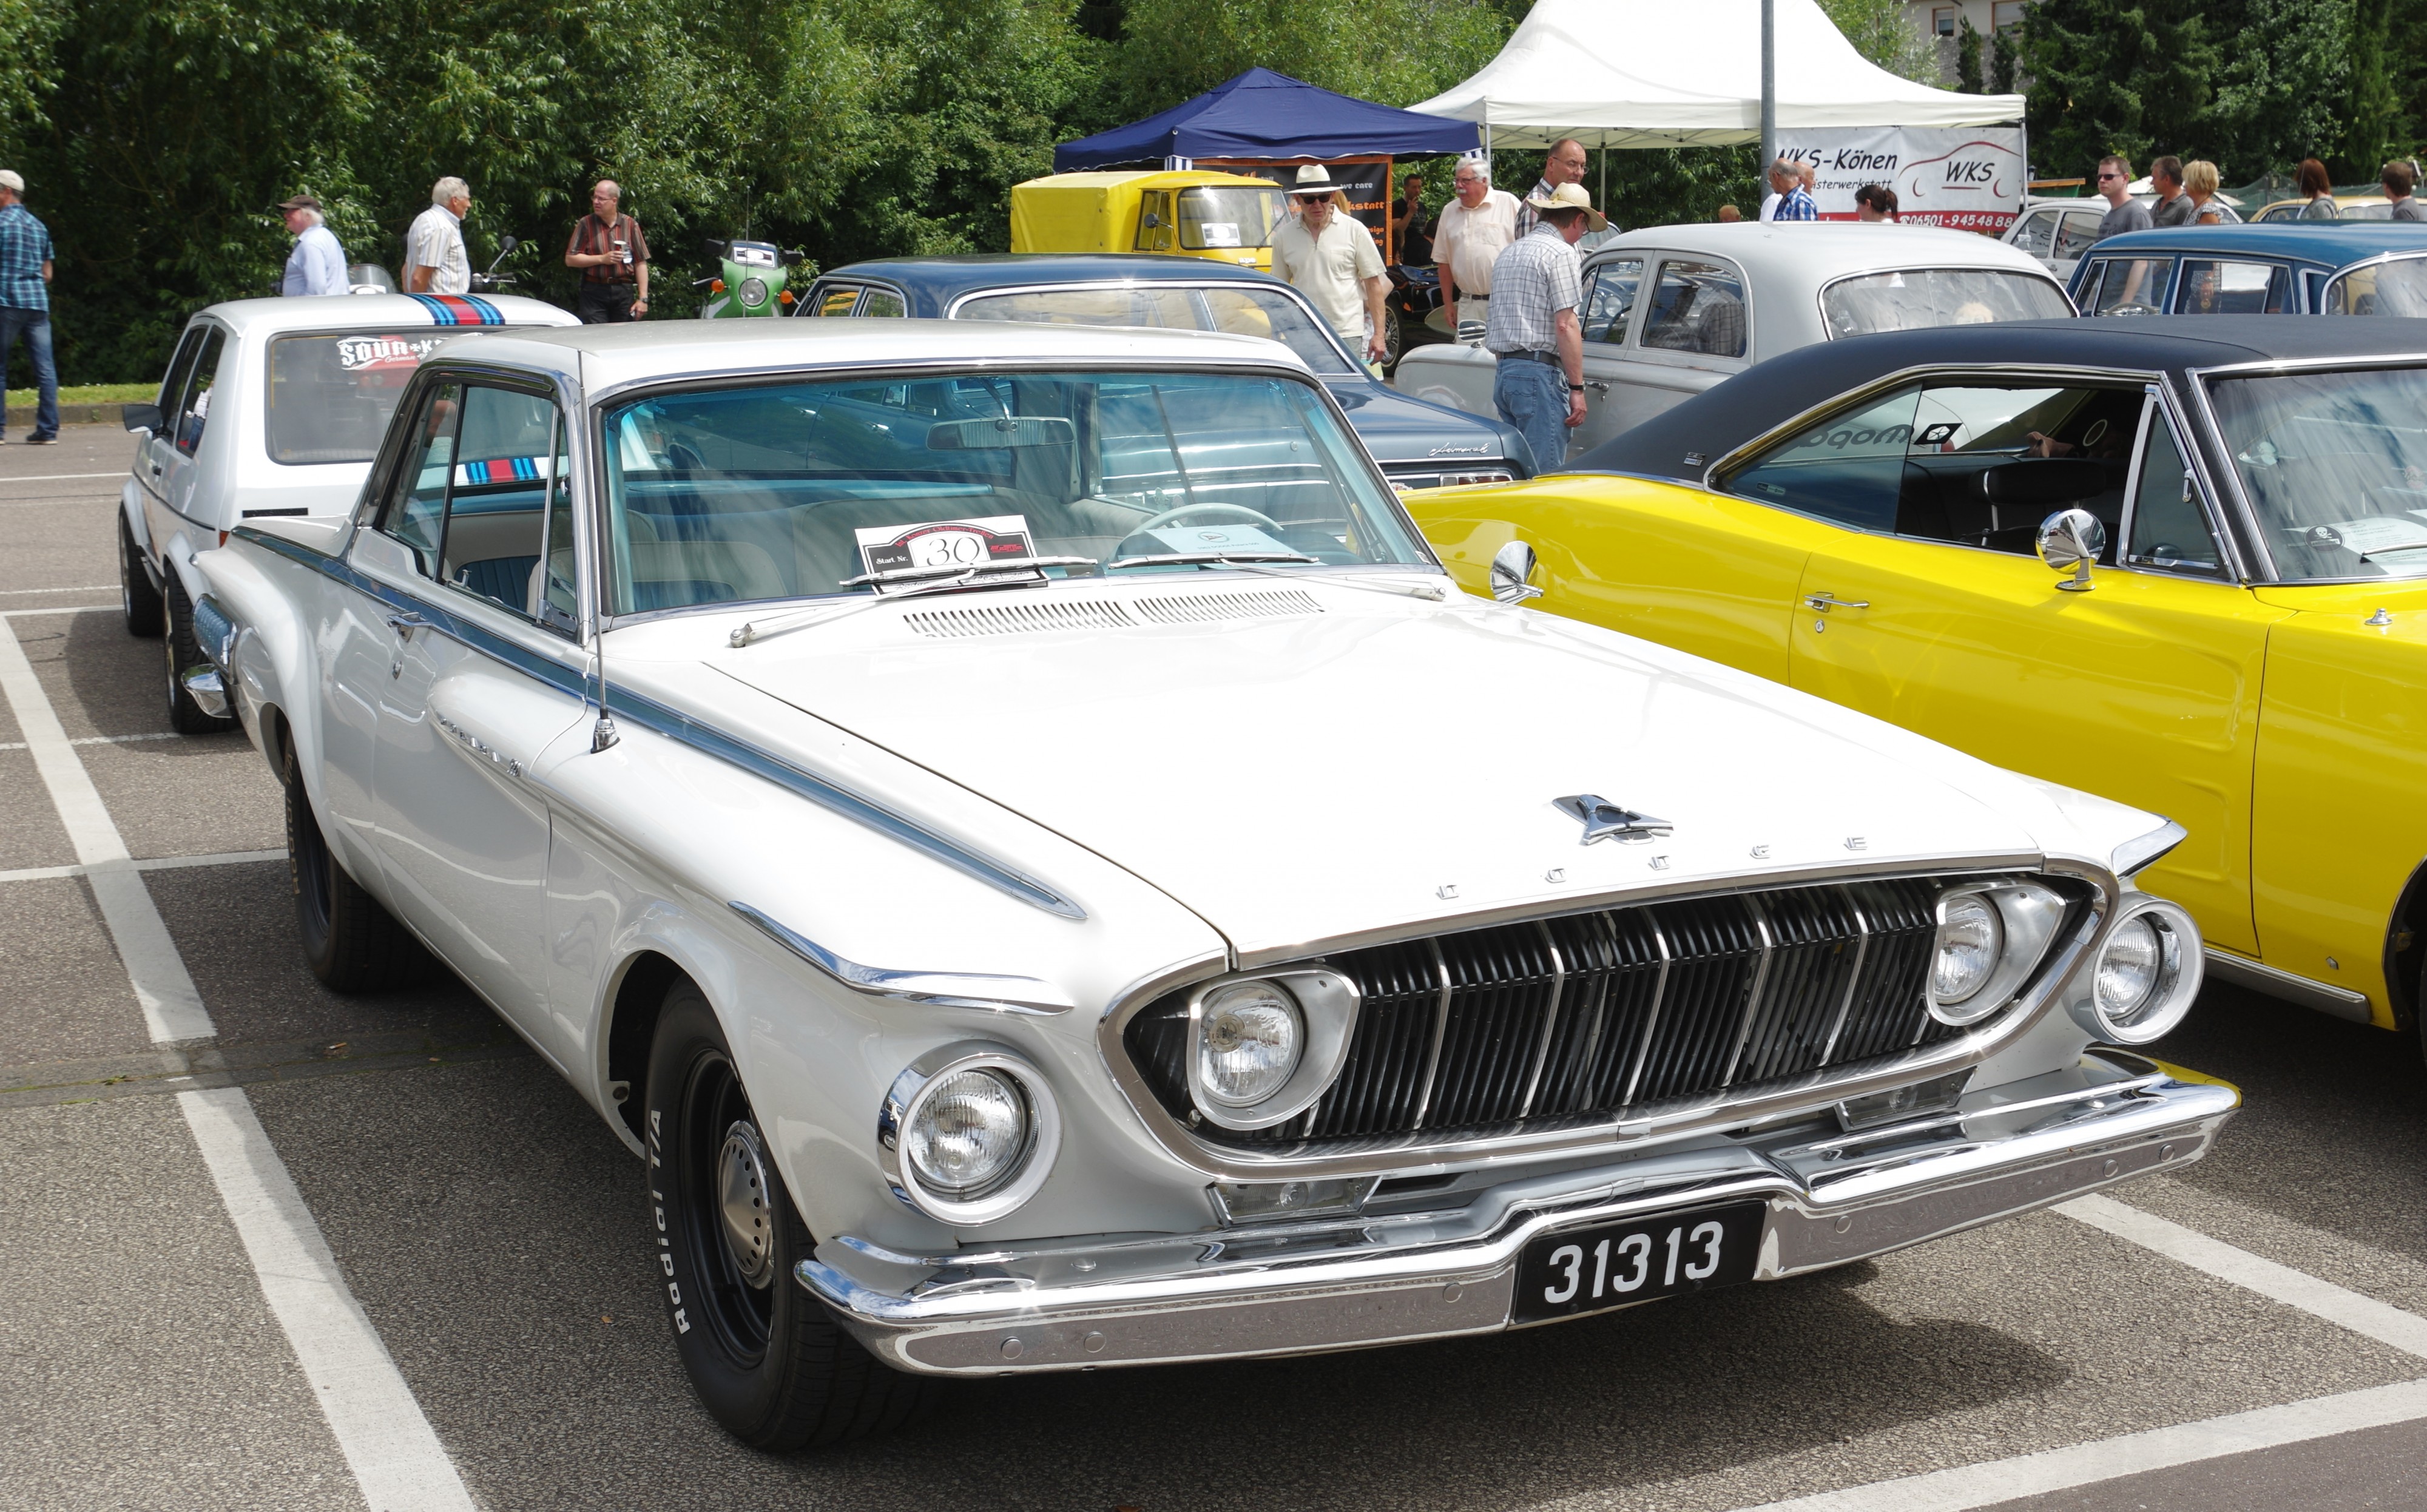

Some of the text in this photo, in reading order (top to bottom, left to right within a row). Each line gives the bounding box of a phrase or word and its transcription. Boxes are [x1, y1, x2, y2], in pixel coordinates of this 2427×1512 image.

[1946, 160, 1995, 183] WKS
[1348, 201, 1385, 211] kstatt
[927, 536, 981, 567] 30
[649, 1110, 691, 1335] Radial T/A
[1544, 1221, 1724, 1304] 31313
